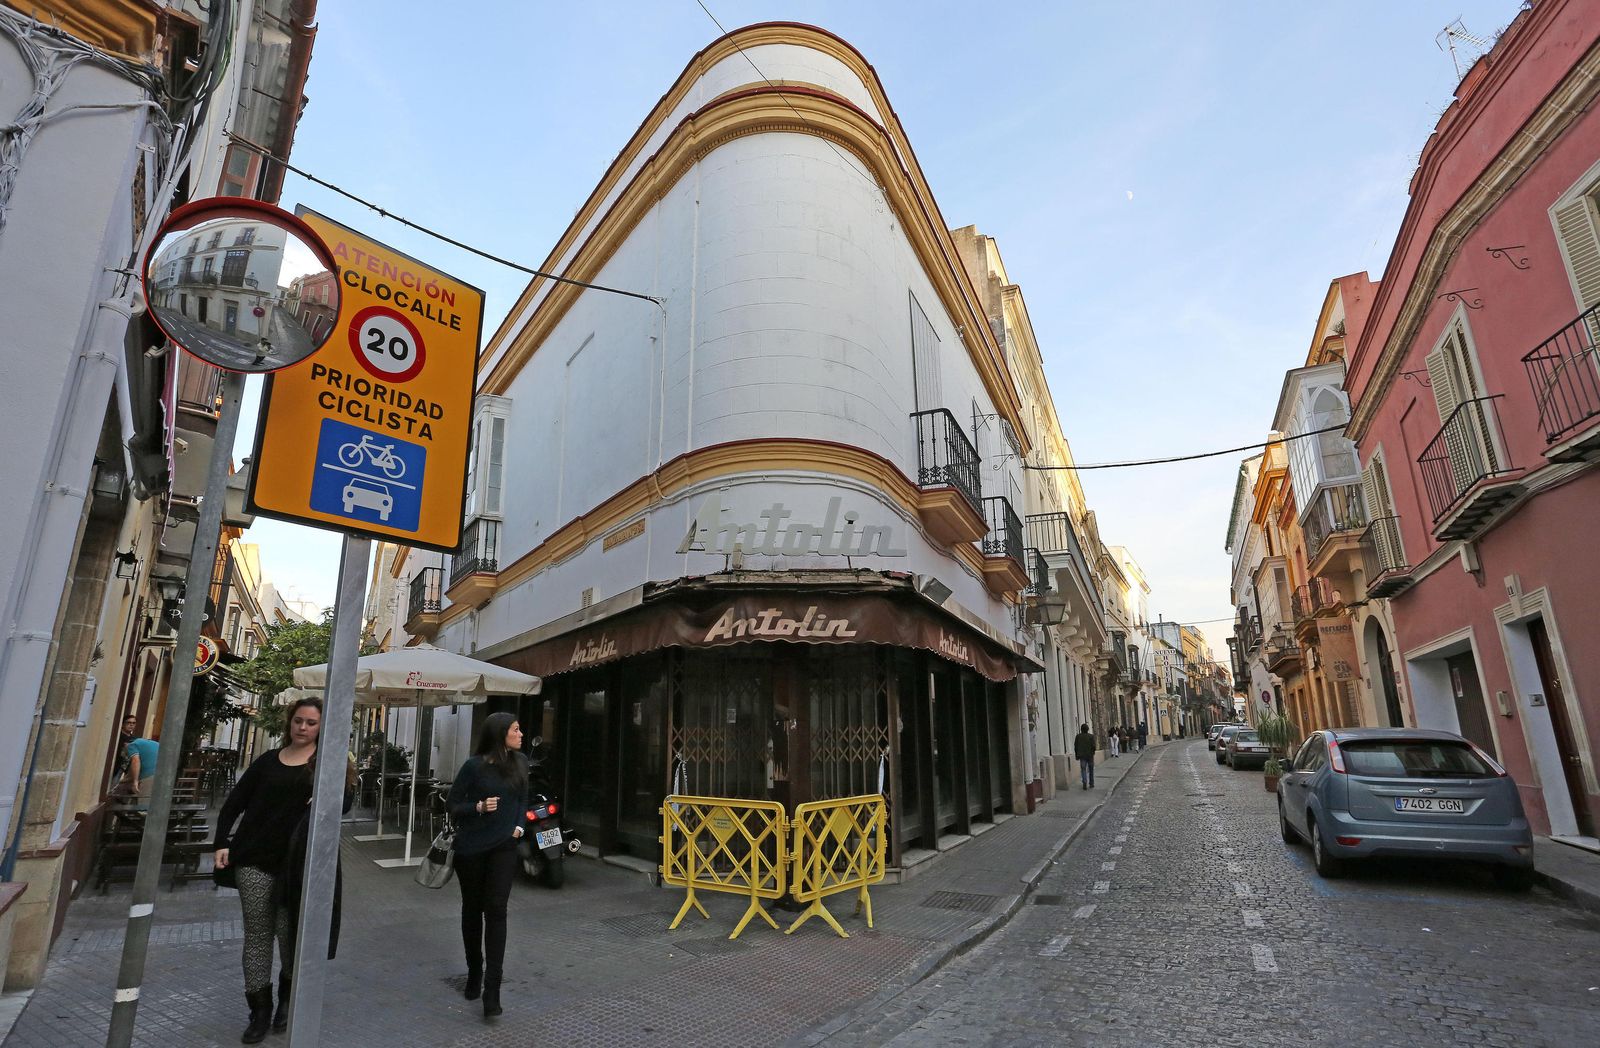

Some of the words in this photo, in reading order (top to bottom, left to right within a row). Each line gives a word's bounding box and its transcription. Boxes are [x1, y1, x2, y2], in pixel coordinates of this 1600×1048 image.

[333, 241, 456, 307] ATENCIÓN
[337, 265, 462, 332] CLOCALLE
[366, 326, 410, 361] 20
[310, 362, 444, 421] PRIORIDAD
[317, 391, 434, 441] CICLISTA
[676, 495, 908, 557] Antolin
[703, 605, 857, 643] Antolin
[569, 633, 618, 666] Antolin
[939, 626, 969, 661] Antolin
[416, 680, 448, 689] Cruzcampo
[1402, 798, 1433, 810] 7402
[1438, 800, 1461, 811] GGN
[542, 830, 559, 840] 5492
[543, 838, 557, 847] GML
